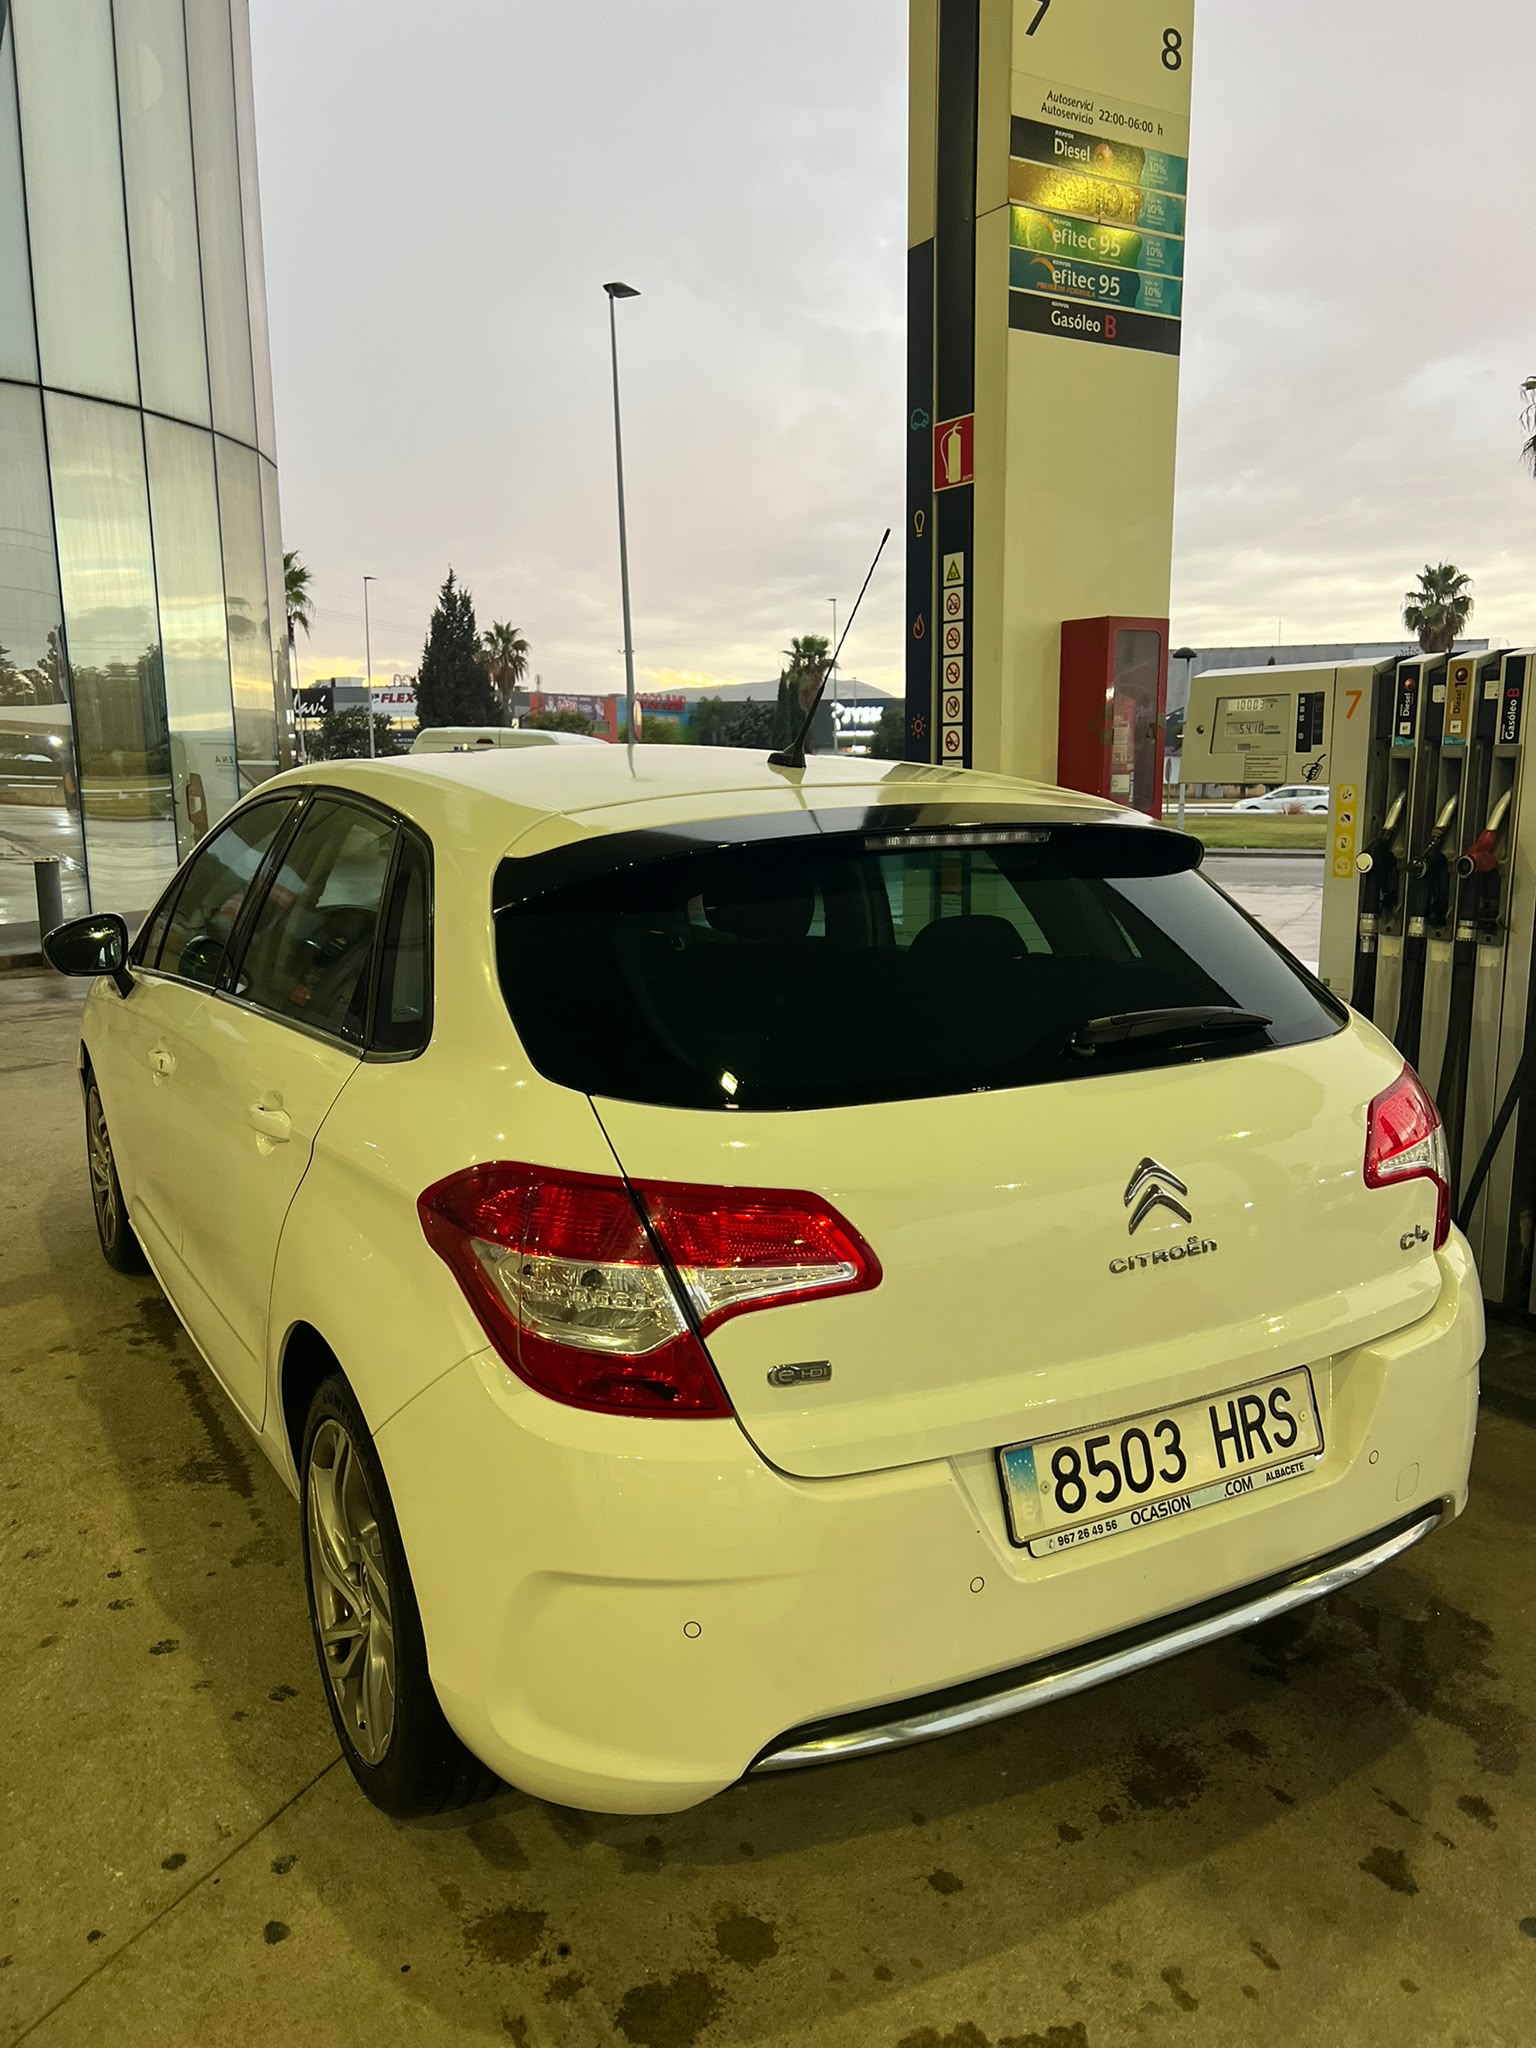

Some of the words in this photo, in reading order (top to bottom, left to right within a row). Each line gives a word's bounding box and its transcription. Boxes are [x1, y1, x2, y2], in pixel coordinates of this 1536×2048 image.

[1025, 0, 1050, 36] 7
[1162, 28, 1182, 71] 8
[1041, 102, 1094, 126] Autoservicio
[1046, 90, 1094, 112] Autoservici
[1098, 109, 1153, 133] 22:00-06:00
[1157, 123, 1163, 136] h
[1054, 138, 1091, 162] Diesel
[1052, 227, 1096, 251] efitec
[1100, 235, 1121, 257] 95
[1146, 245, 1163, 258] 10%
[1052, 269, 1096, 291] efitec
[1099, 274, 1120, 297] 95
[1144, 285, 1161, 298] 10%
[1051, 309, 1101, 333] Gasóleo
[1104, 314, 1117, 339] B
[381, 692, 415, 703] FLEX
[1345, 690, 1363, 719] 7
[1402, 692, 1411, 717] Diesel
[1506, 687, 1520, 698] B
[1505, 699, 1518, 740] Gasóleo
[1400, 1224, 1430, 1250] C4
[1051, 1418, 1188, 1514] 8503
[1208, 1386, 1299, 1469] HRS
[1265, 1461, 1305, 1482] ALBACETE
[1130, 1494, 1192, 1525] OCASION
[1224, 1475, 1254, 1498] .COM
[1057, 1532, 1075, 1546] 967
[1077, 1528, 1090, 1540] 26
[1092, 1524, 1104, 1535] 49
[1105, 1520, 1118, 1531] 56
